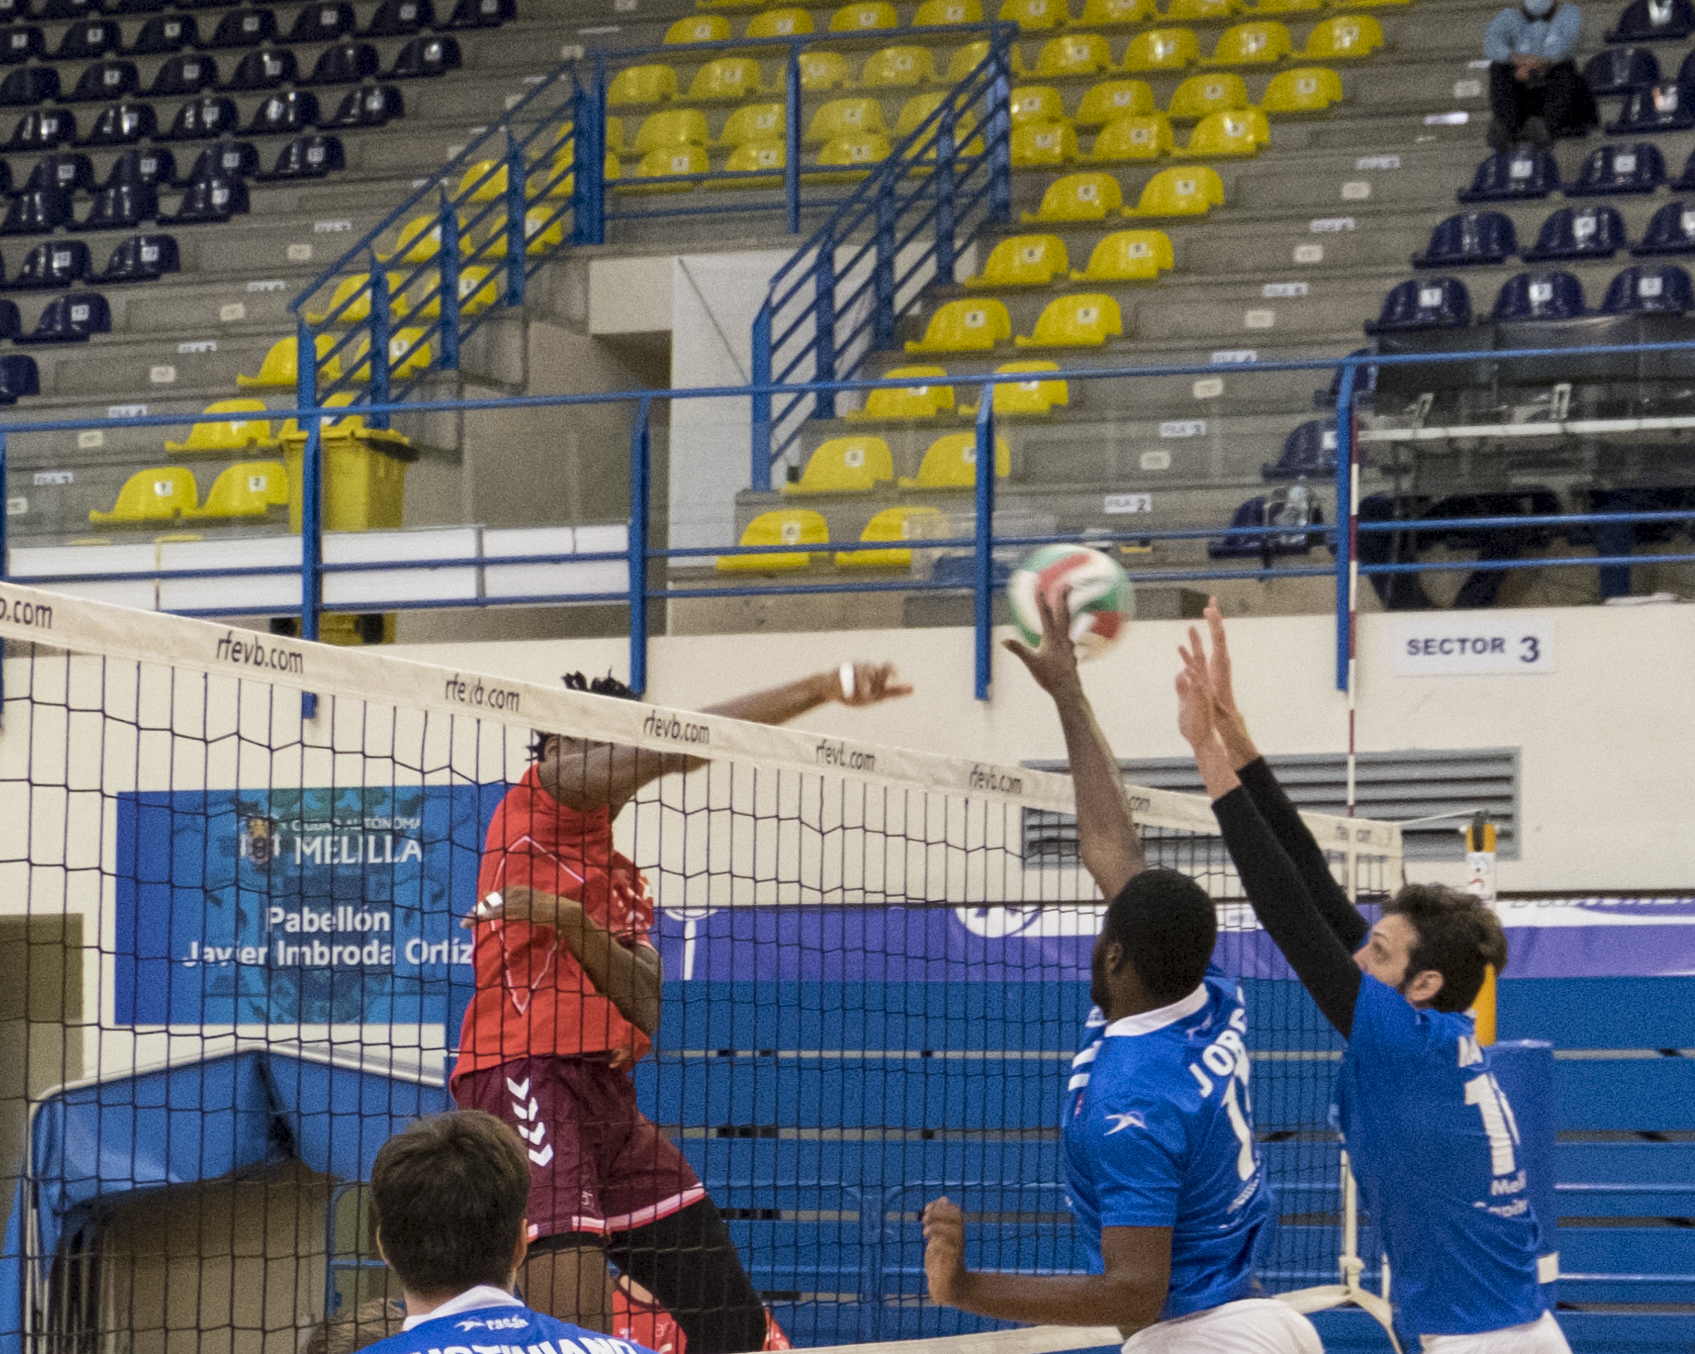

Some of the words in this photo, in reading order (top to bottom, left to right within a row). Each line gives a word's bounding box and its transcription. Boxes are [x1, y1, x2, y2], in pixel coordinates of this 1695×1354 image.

[216, 630, 303, 674] rfevb.com
[1406, 636, 1505, 656] SECTOR
[1519, 635, 1540, 663] 3
[643, 709, 710, 745] rfevb.com
[294, 834, 422, 865] MELILLA
[265, 905, 391, 933] Pabellón
[183, 940, 268, 968] Javier
[277, 939, 396, 966] Imbroda
